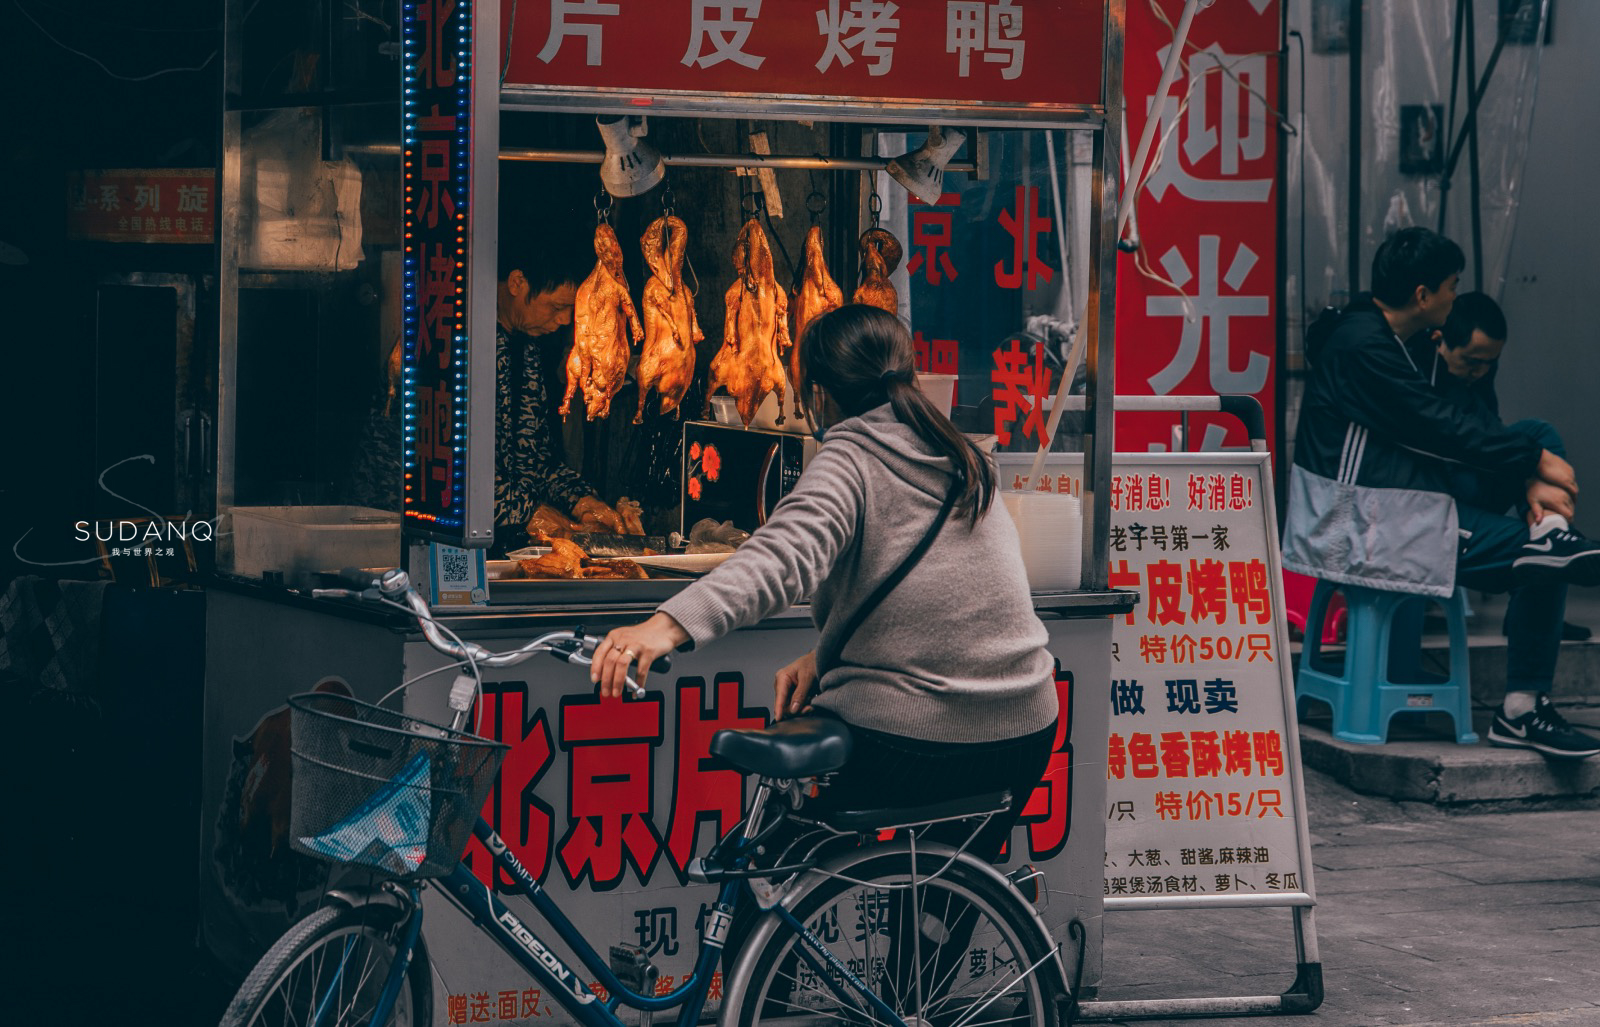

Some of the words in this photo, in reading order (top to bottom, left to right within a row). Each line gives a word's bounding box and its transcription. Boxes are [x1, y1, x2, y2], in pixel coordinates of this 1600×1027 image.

[536, 0, 1026, 80] 片皮烤鸭
[1146, 0, 1275, 452] 迎光
[414, 0, 457, 508] 北京烤鸭
[1187, 473, 1253, 511] 好消息!
[1110, 523, 1231, 551] 老字号第一家
[1140, 634, 1274, 664] 特价50/只
[1165, 677, 1239, 715] 现卖
[1155, 789, 1285, 821] 特价15/只
[1104, 846, 1270, 868] 、大葱、甜酱,麻辣油
[499, 911, 570, 981] PIGEON
